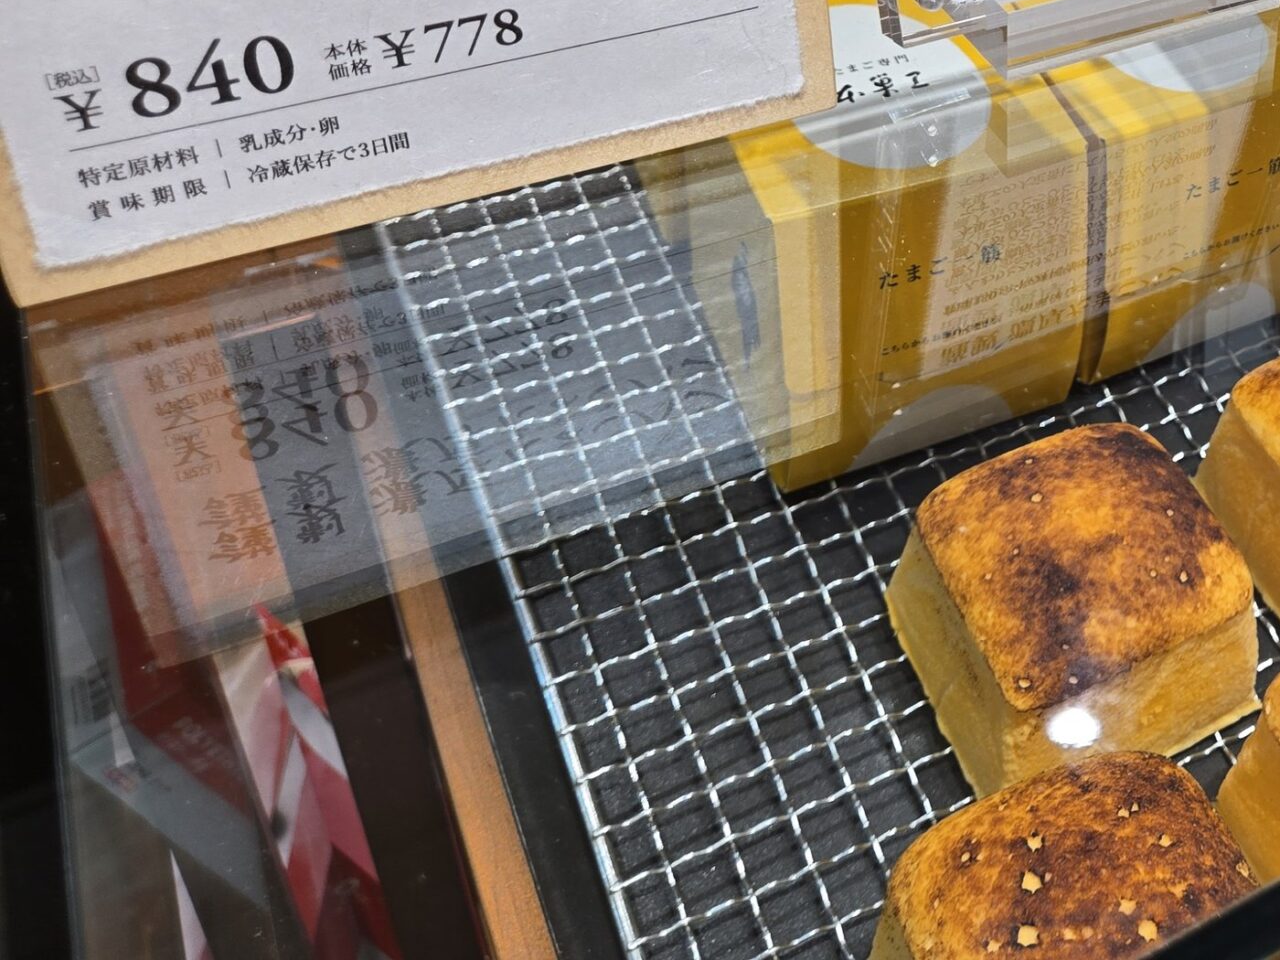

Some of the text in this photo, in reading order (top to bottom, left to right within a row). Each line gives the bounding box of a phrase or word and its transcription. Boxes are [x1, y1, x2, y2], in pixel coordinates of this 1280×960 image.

[324, 38, 368, 60] 本体
[373, 8, 524, 69] ¥778
[126, 35, 295, 118] 840
[328, 62, 372, 81] 価格
[77, 146, 200, 189] 特定原材料
[87, 131, 411, 221] 賞味期限 冷蔵保存で3日間
